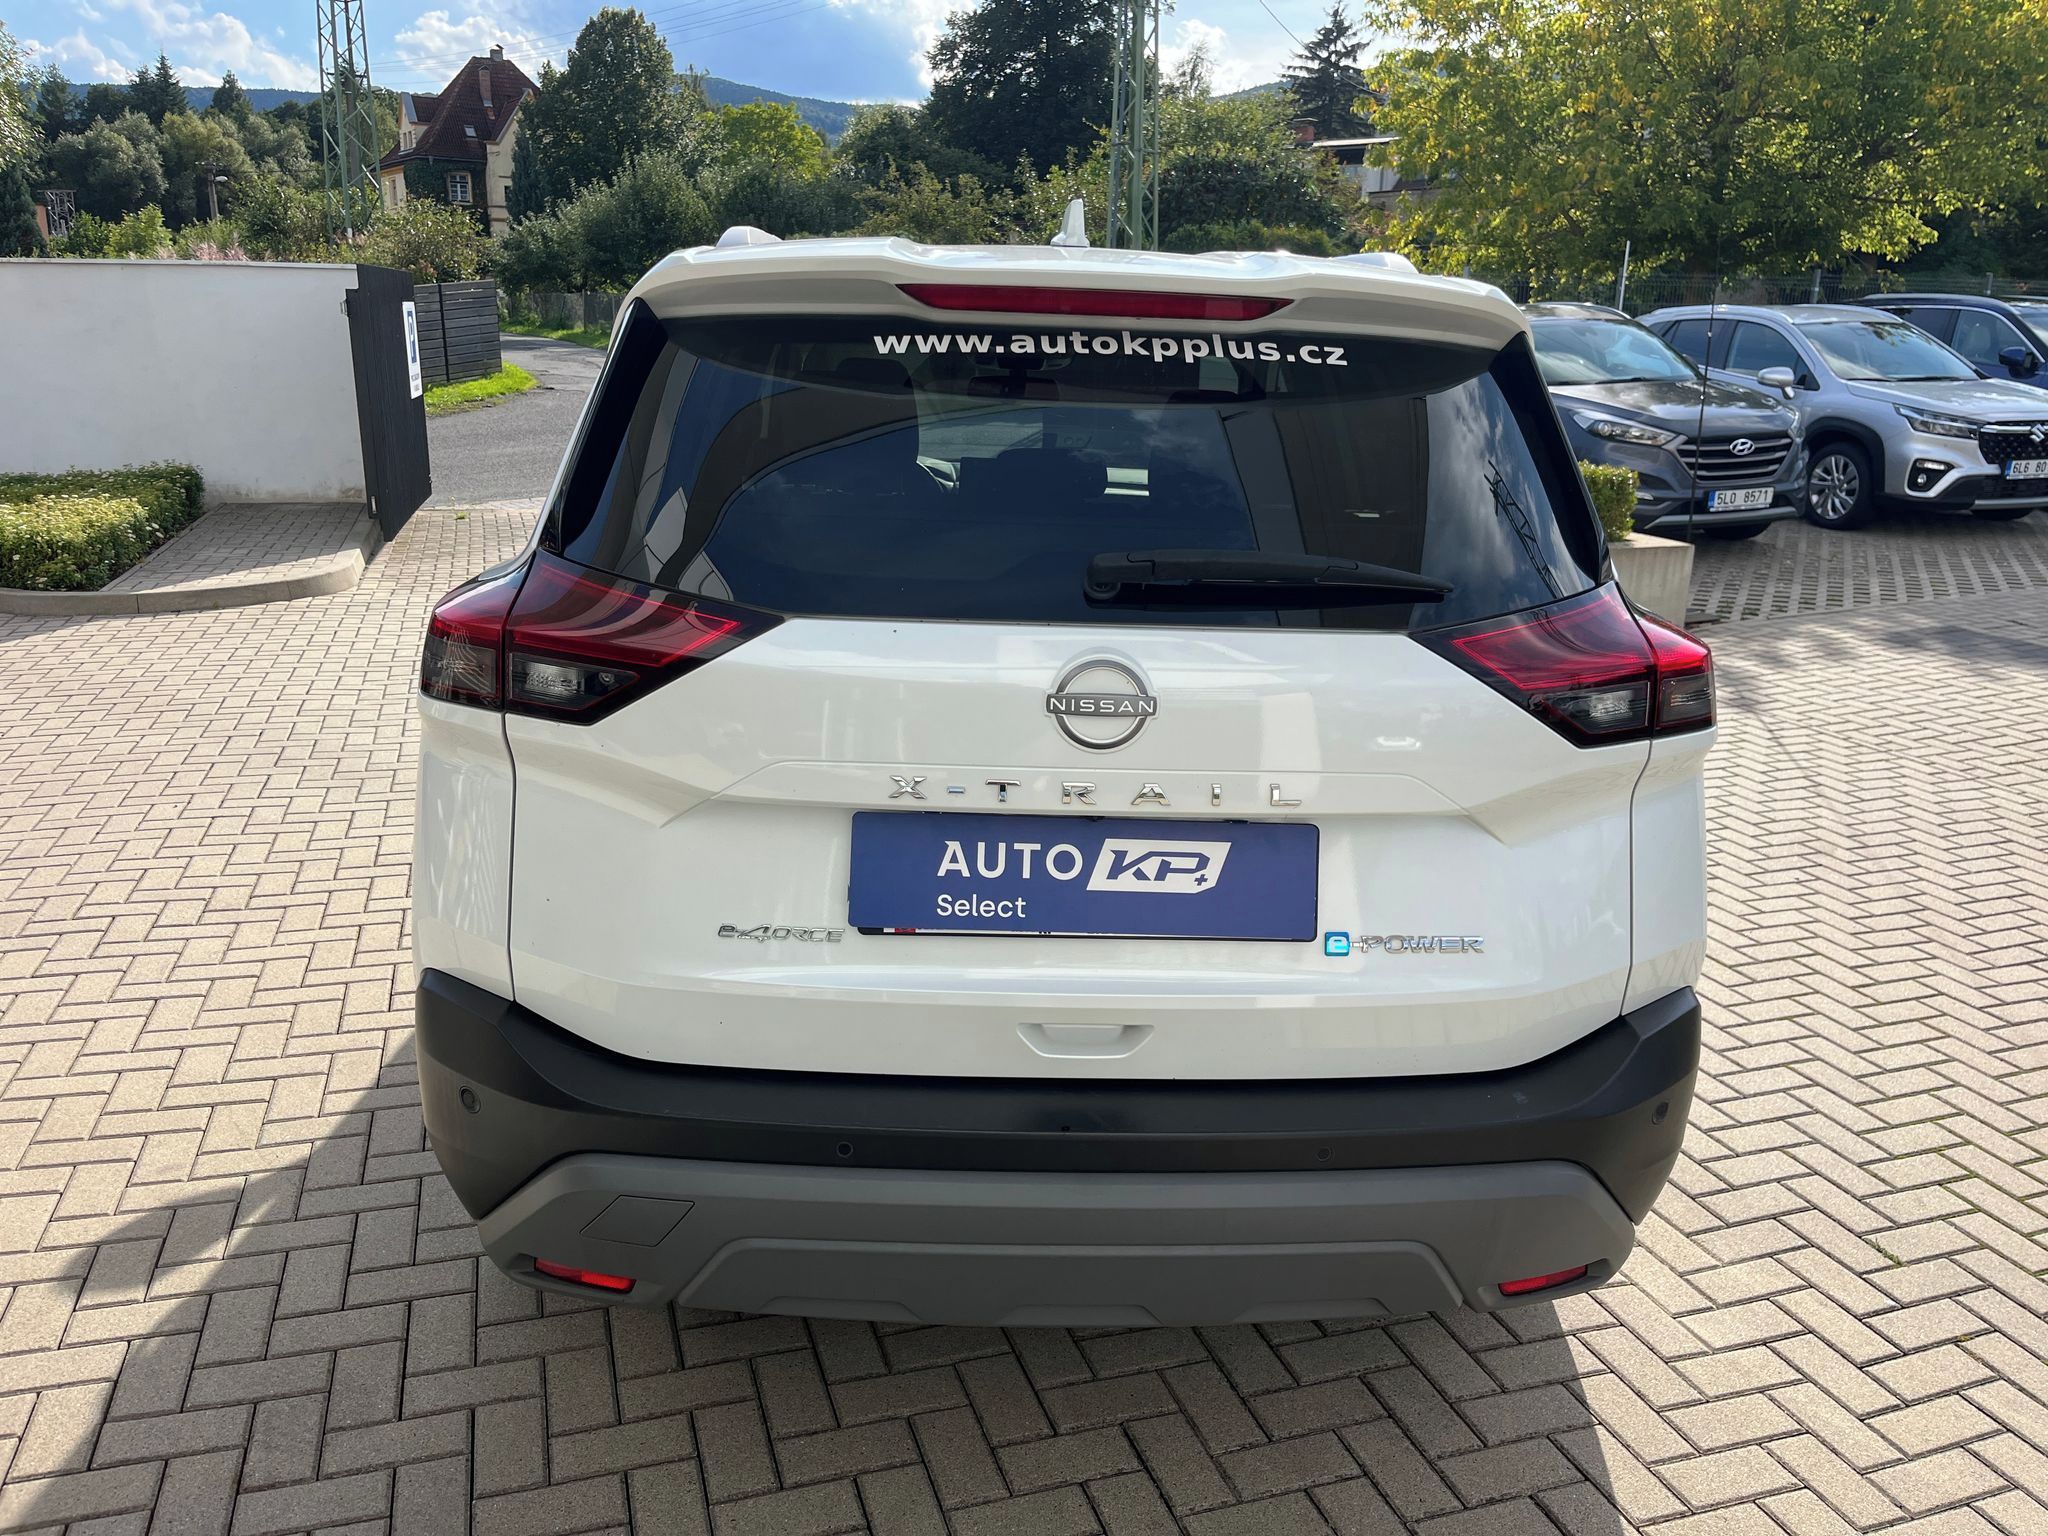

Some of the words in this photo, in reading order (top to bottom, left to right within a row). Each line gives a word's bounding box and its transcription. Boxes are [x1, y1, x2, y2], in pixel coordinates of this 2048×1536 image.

[873, 330, 1348, 366] www.autokpplus.cz
[1743, 490, 1769, 503] 8571
[1049, 697, 1155, 714] NISSAN
[889, 775, 1302, 807] X-TRAIL
[936, 840, 1083, 881] AUTO
[936, 893, 1027, 918] Select
[1325, 932, 1485, 957] e-POWER
